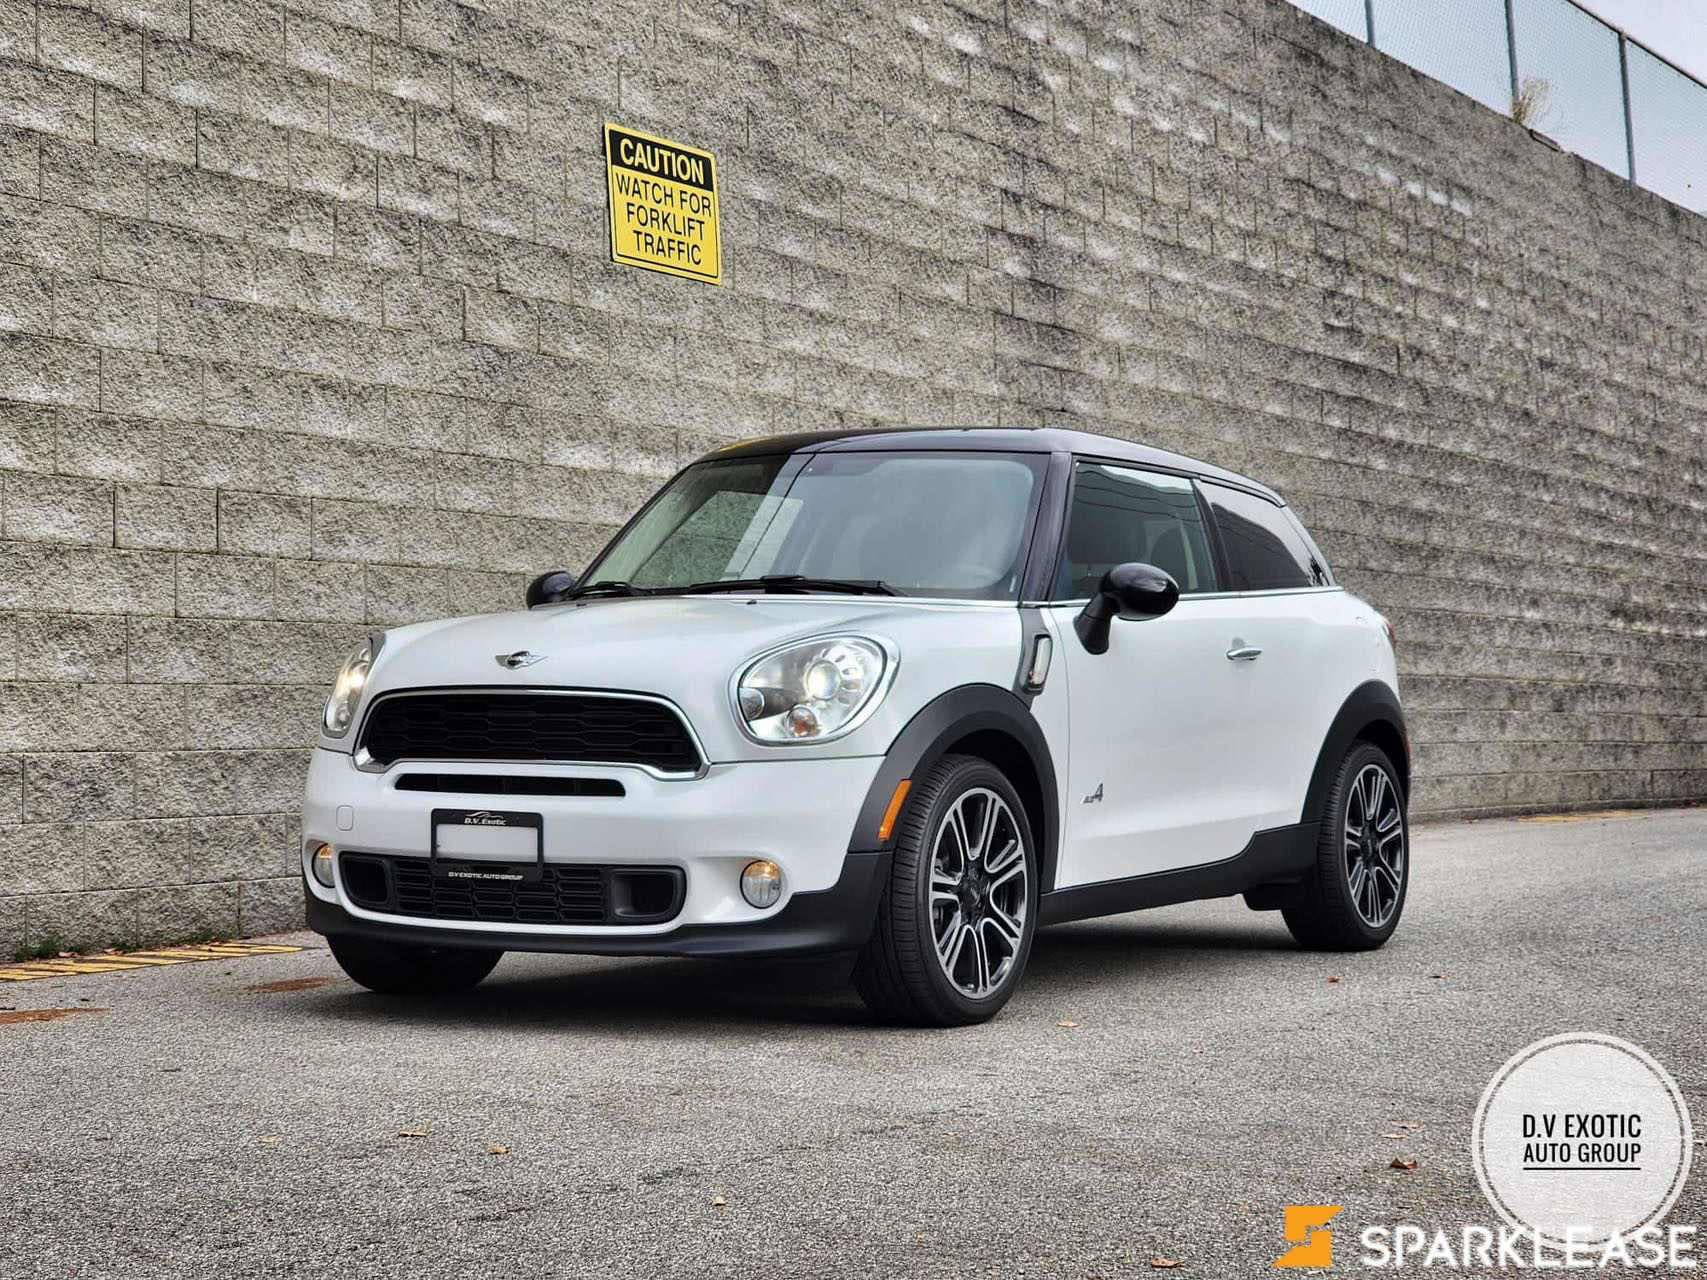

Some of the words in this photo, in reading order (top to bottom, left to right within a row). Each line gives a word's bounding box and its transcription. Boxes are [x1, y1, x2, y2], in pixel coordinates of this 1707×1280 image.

[620, 138, 705, 185] CAUTION
[616, 172, 674, 208] WATCH
[680, 190, 712, 217] FOR
[626, 202, 705, 241] FORKLIFT
[633, 230, 702, 265] TRAFFIC
